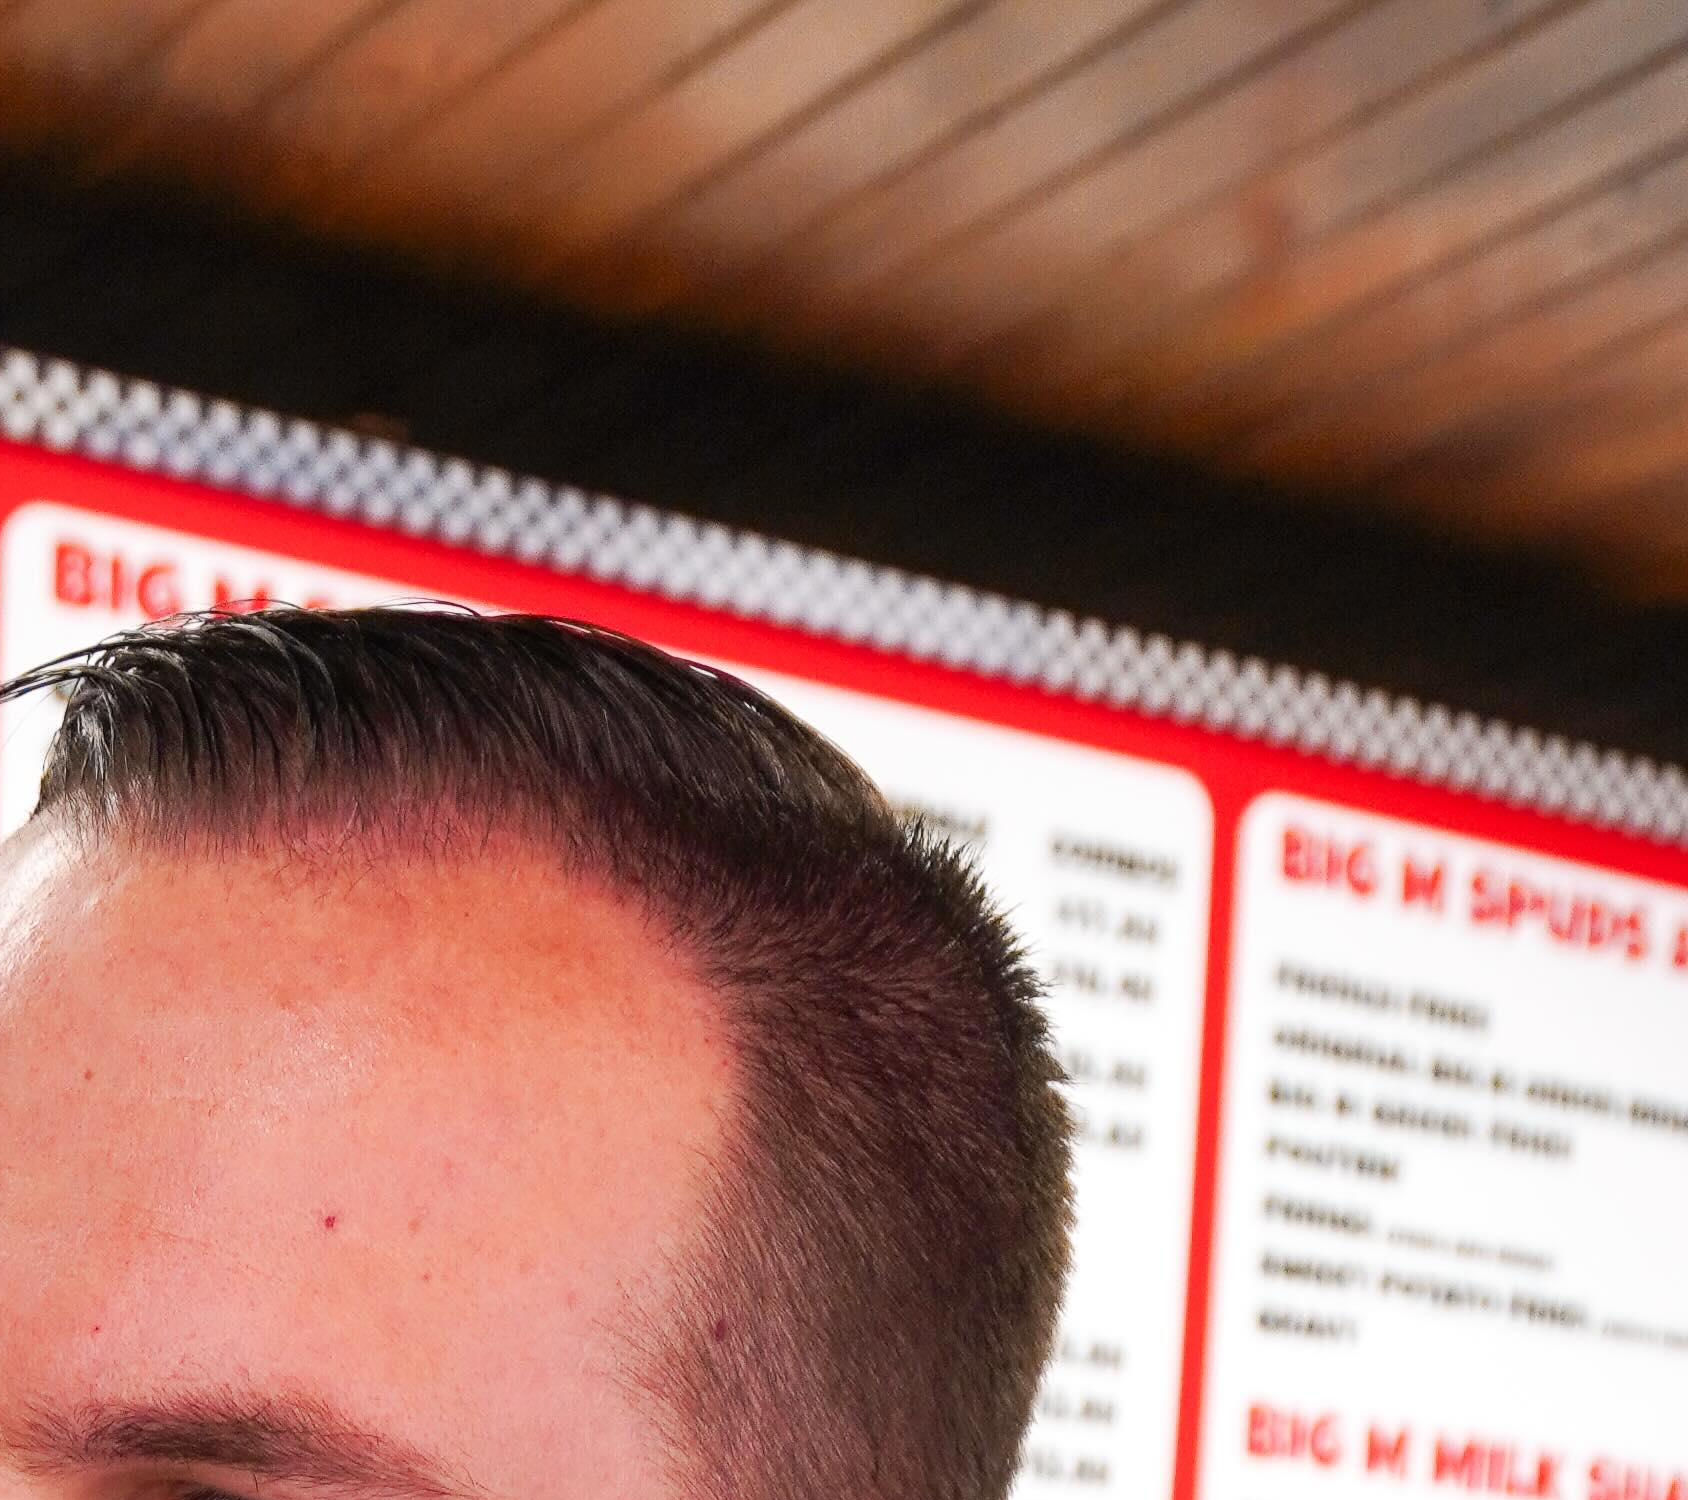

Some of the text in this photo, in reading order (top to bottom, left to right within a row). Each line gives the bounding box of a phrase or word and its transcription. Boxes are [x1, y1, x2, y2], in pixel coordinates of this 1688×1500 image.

[54, 540, 184, 619] BIG
[1280, 825, 1383, 895] BIG
[1401, 848, 1449, 905] M
[1468, 860, 1646, 956] SPUDS
[1247, 1403, 1341, 1465] BIG
[1366, 1426, 1407, 1475] M
[1432, 1436, 1558, 1500] MILK
